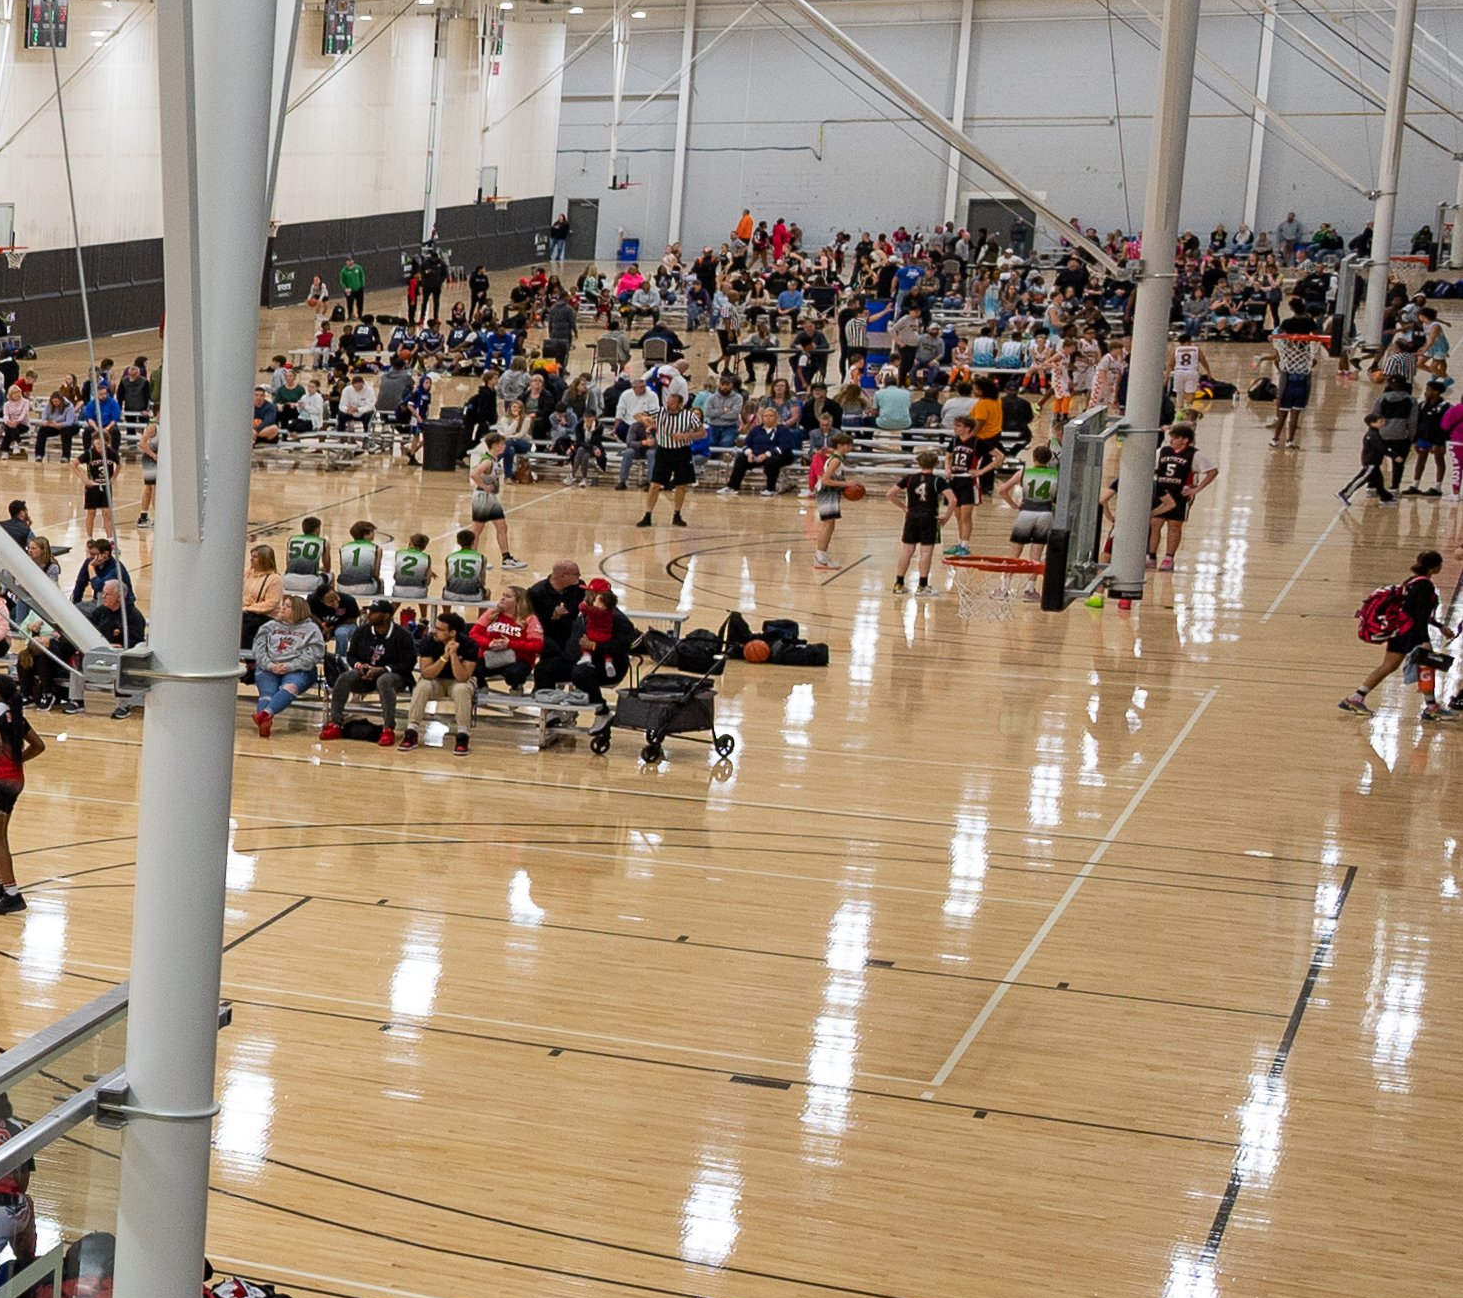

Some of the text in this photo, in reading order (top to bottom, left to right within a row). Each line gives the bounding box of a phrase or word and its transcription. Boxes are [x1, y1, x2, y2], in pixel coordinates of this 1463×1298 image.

[954, 452, 967, 466] 12
[1165, 463, 1177, 477] 5
[915, 482, 927, 502] 4
[1027, 479, 1052, 500] 14
[289, 540, 321, 560] 50
[351, 547, 361, 567] 1
[400, 556, 419, 577] 2
[452, 558, 477, 580] 15
